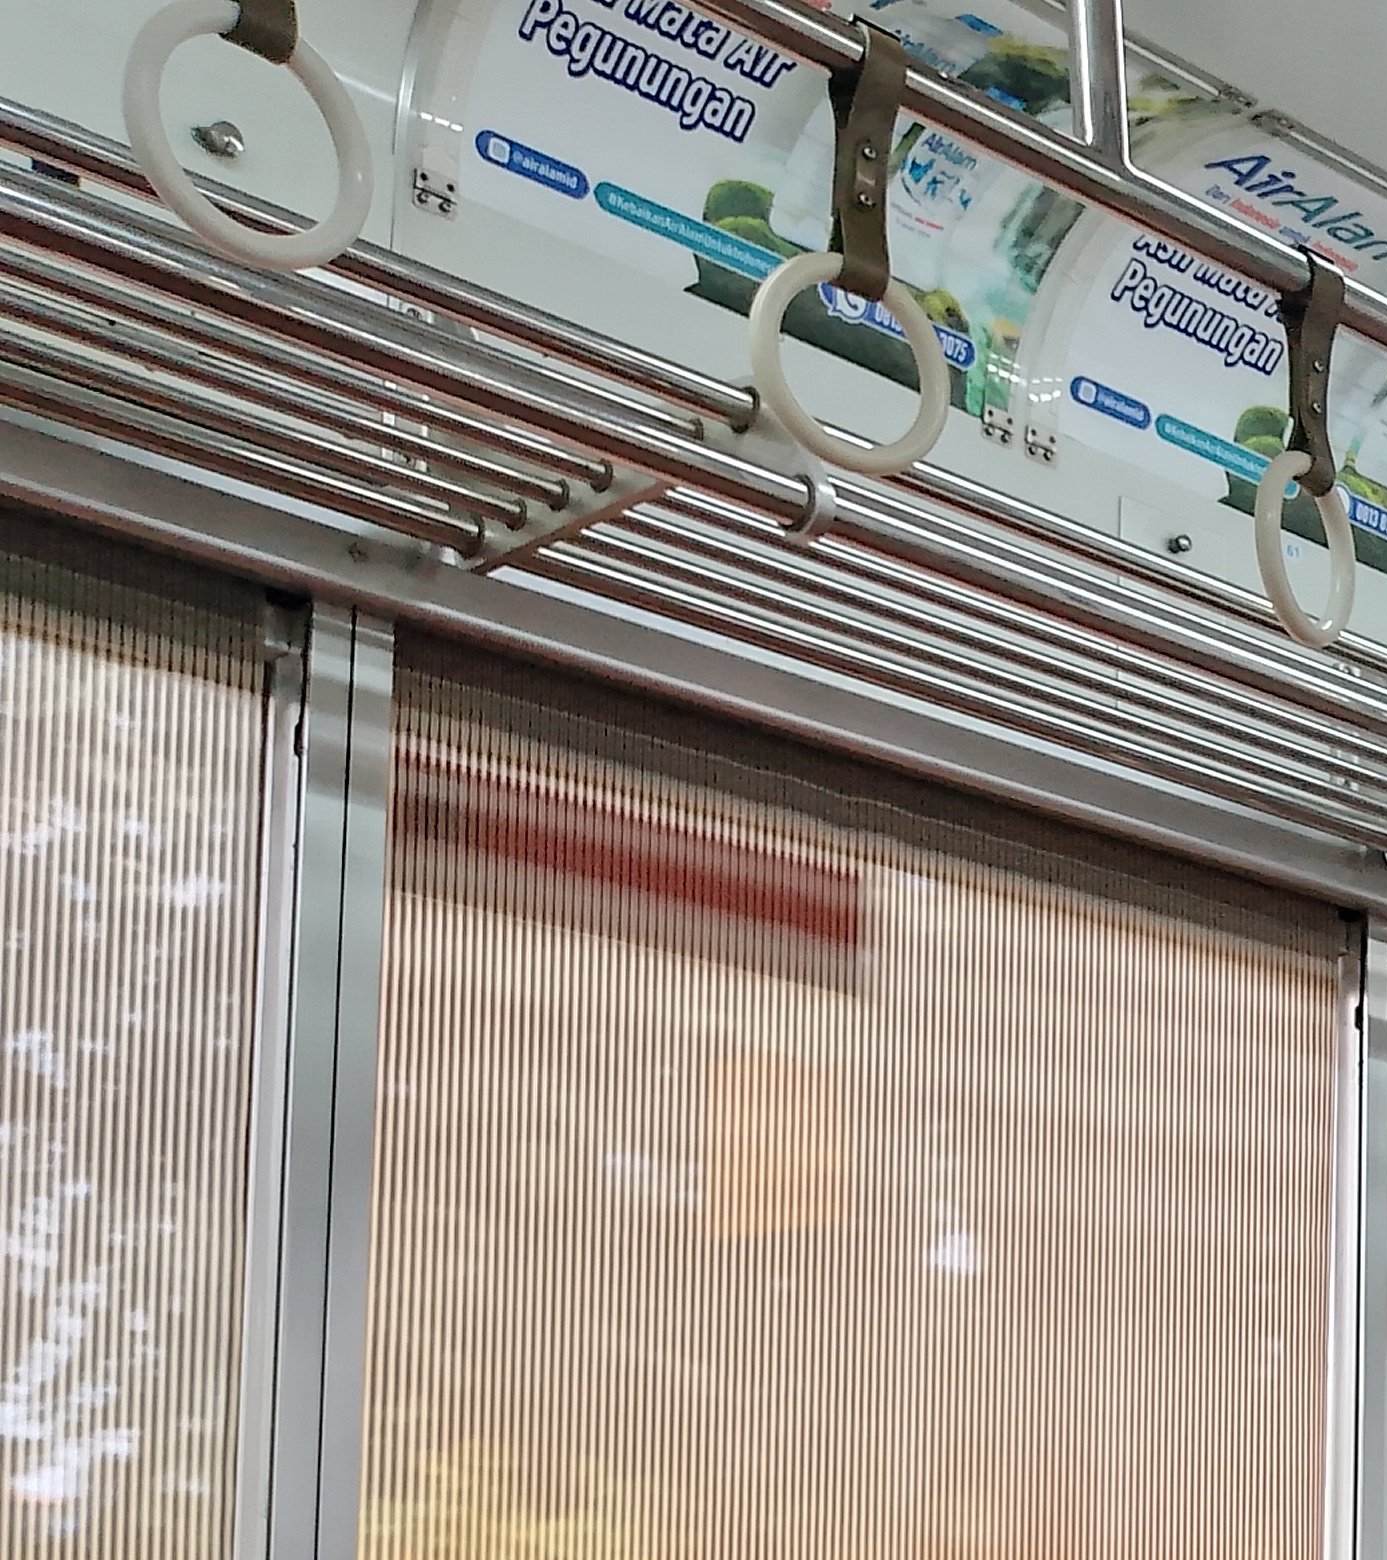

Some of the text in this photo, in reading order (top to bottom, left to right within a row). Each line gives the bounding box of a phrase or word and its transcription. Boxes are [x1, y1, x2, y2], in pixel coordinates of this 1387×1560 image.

[519, 0, 756, 143] Pegunungan
[1111, 256, 1285, 376] Pegunungan
[1355, 502, 1379, 528] 0813
